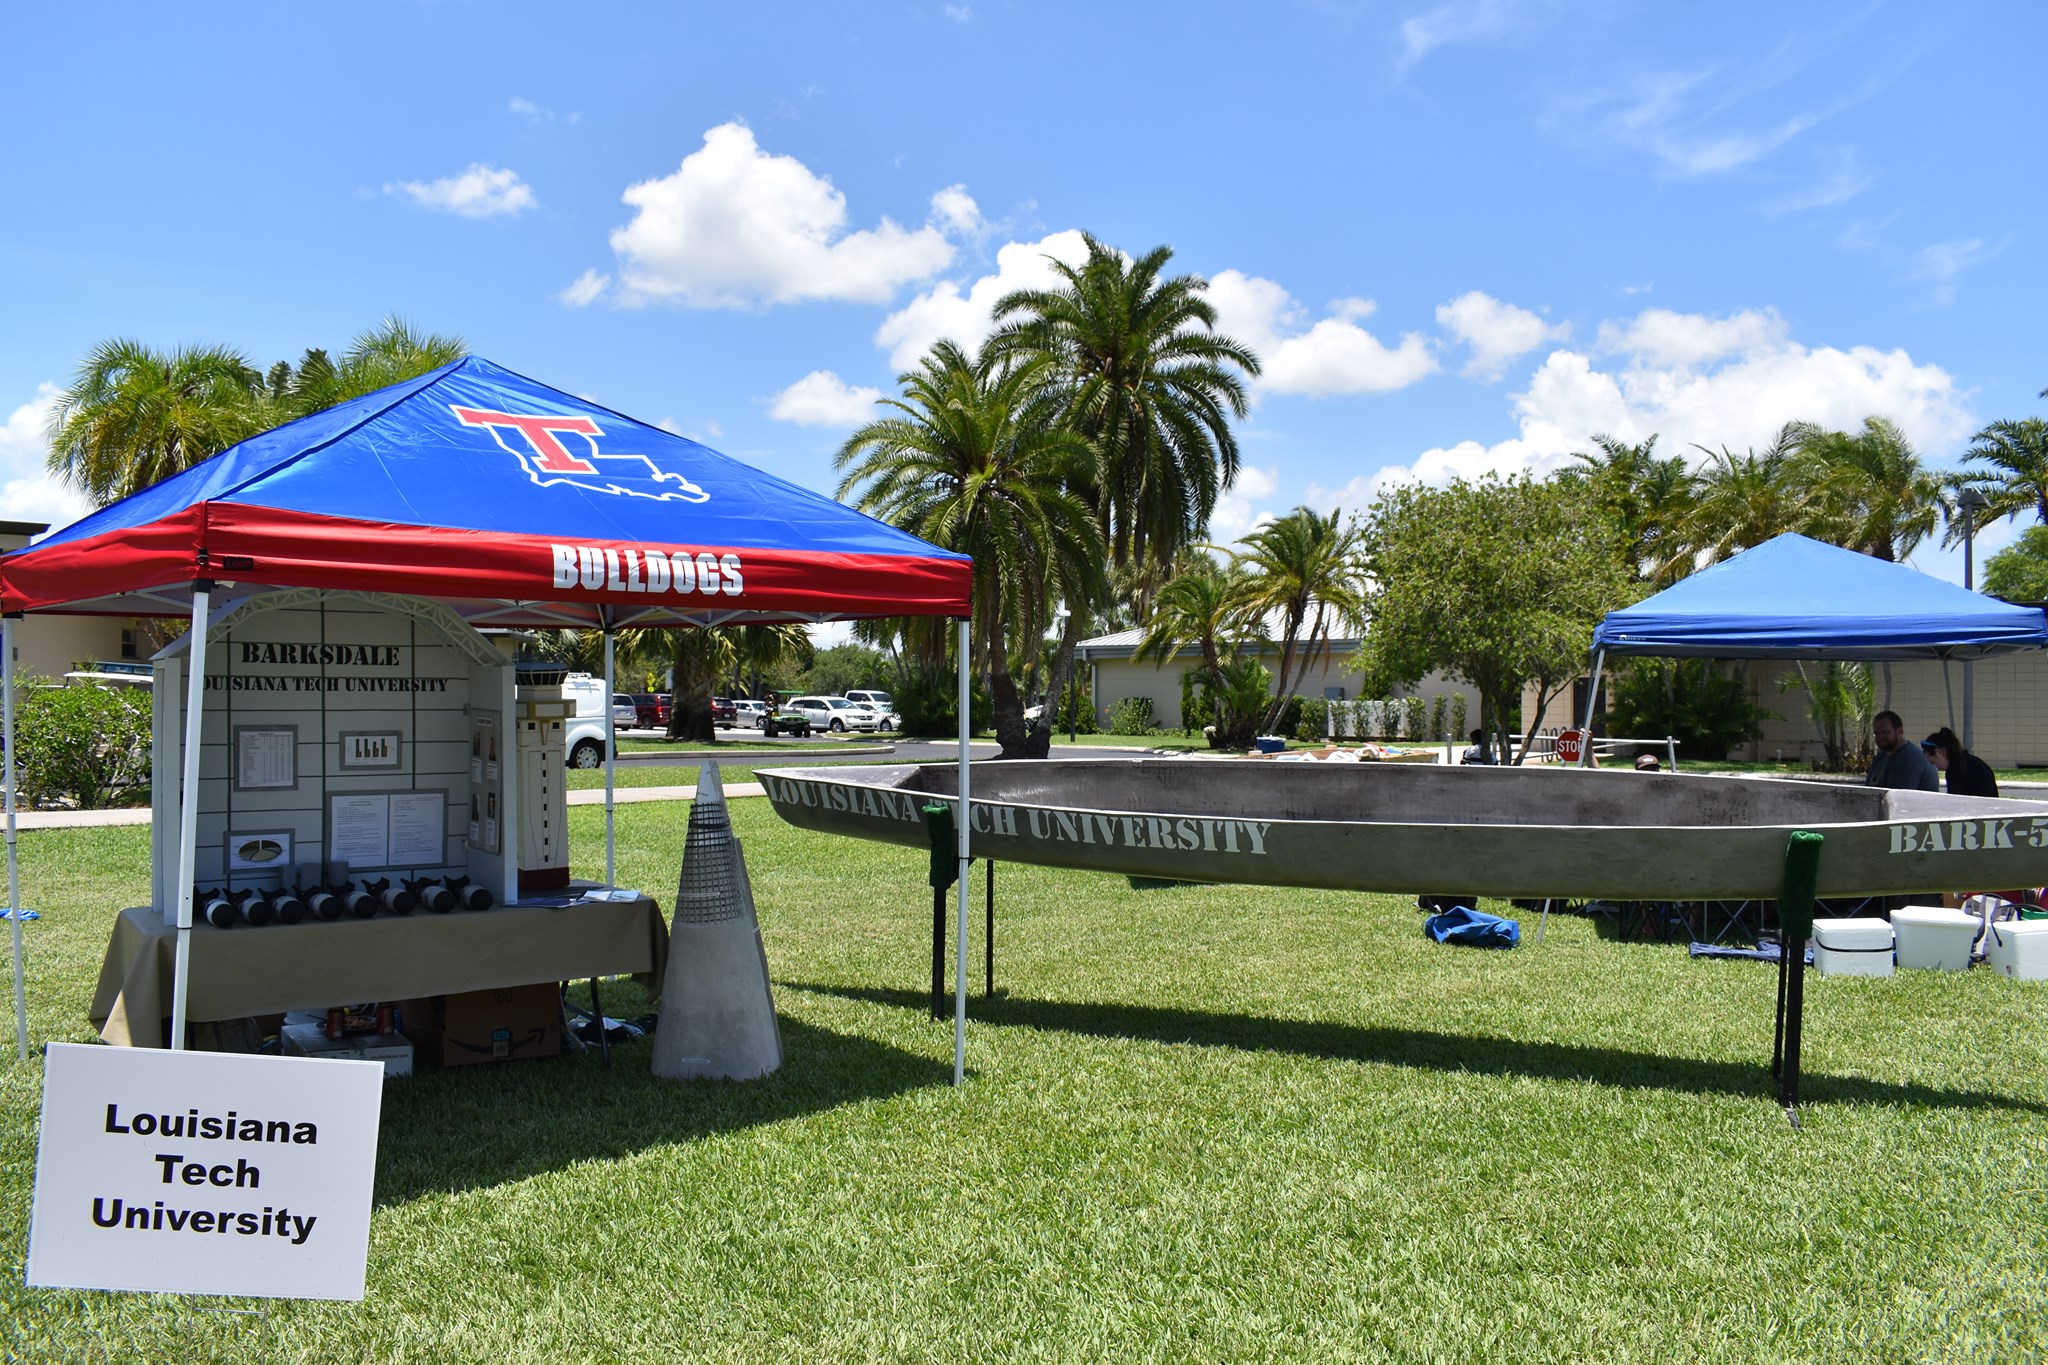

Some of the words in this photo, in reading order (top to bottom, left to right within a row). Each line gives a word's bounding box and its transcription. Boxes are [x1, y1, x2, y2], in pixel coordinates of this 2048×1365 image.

[551, 544, 744, 597] BULLDOGS
[241, 642, 400, 666] BARKSDALE
[203, 676, 287, 691] OUISIANA
[293, 677, 339, 692] TECH
[345, 678, 449, 693] UNIVERSITY
[765, 776, 921, 824] LOUISIANA
[1028, 809, 1272, 856] UNIVERSITY
[1888, 817, 2048, 854] BARK-5
[105, 1103, 318, 1145] Louisiana
[155, 1154, 260, 1188] Tech
[91, 1197, 318, 1245] University
